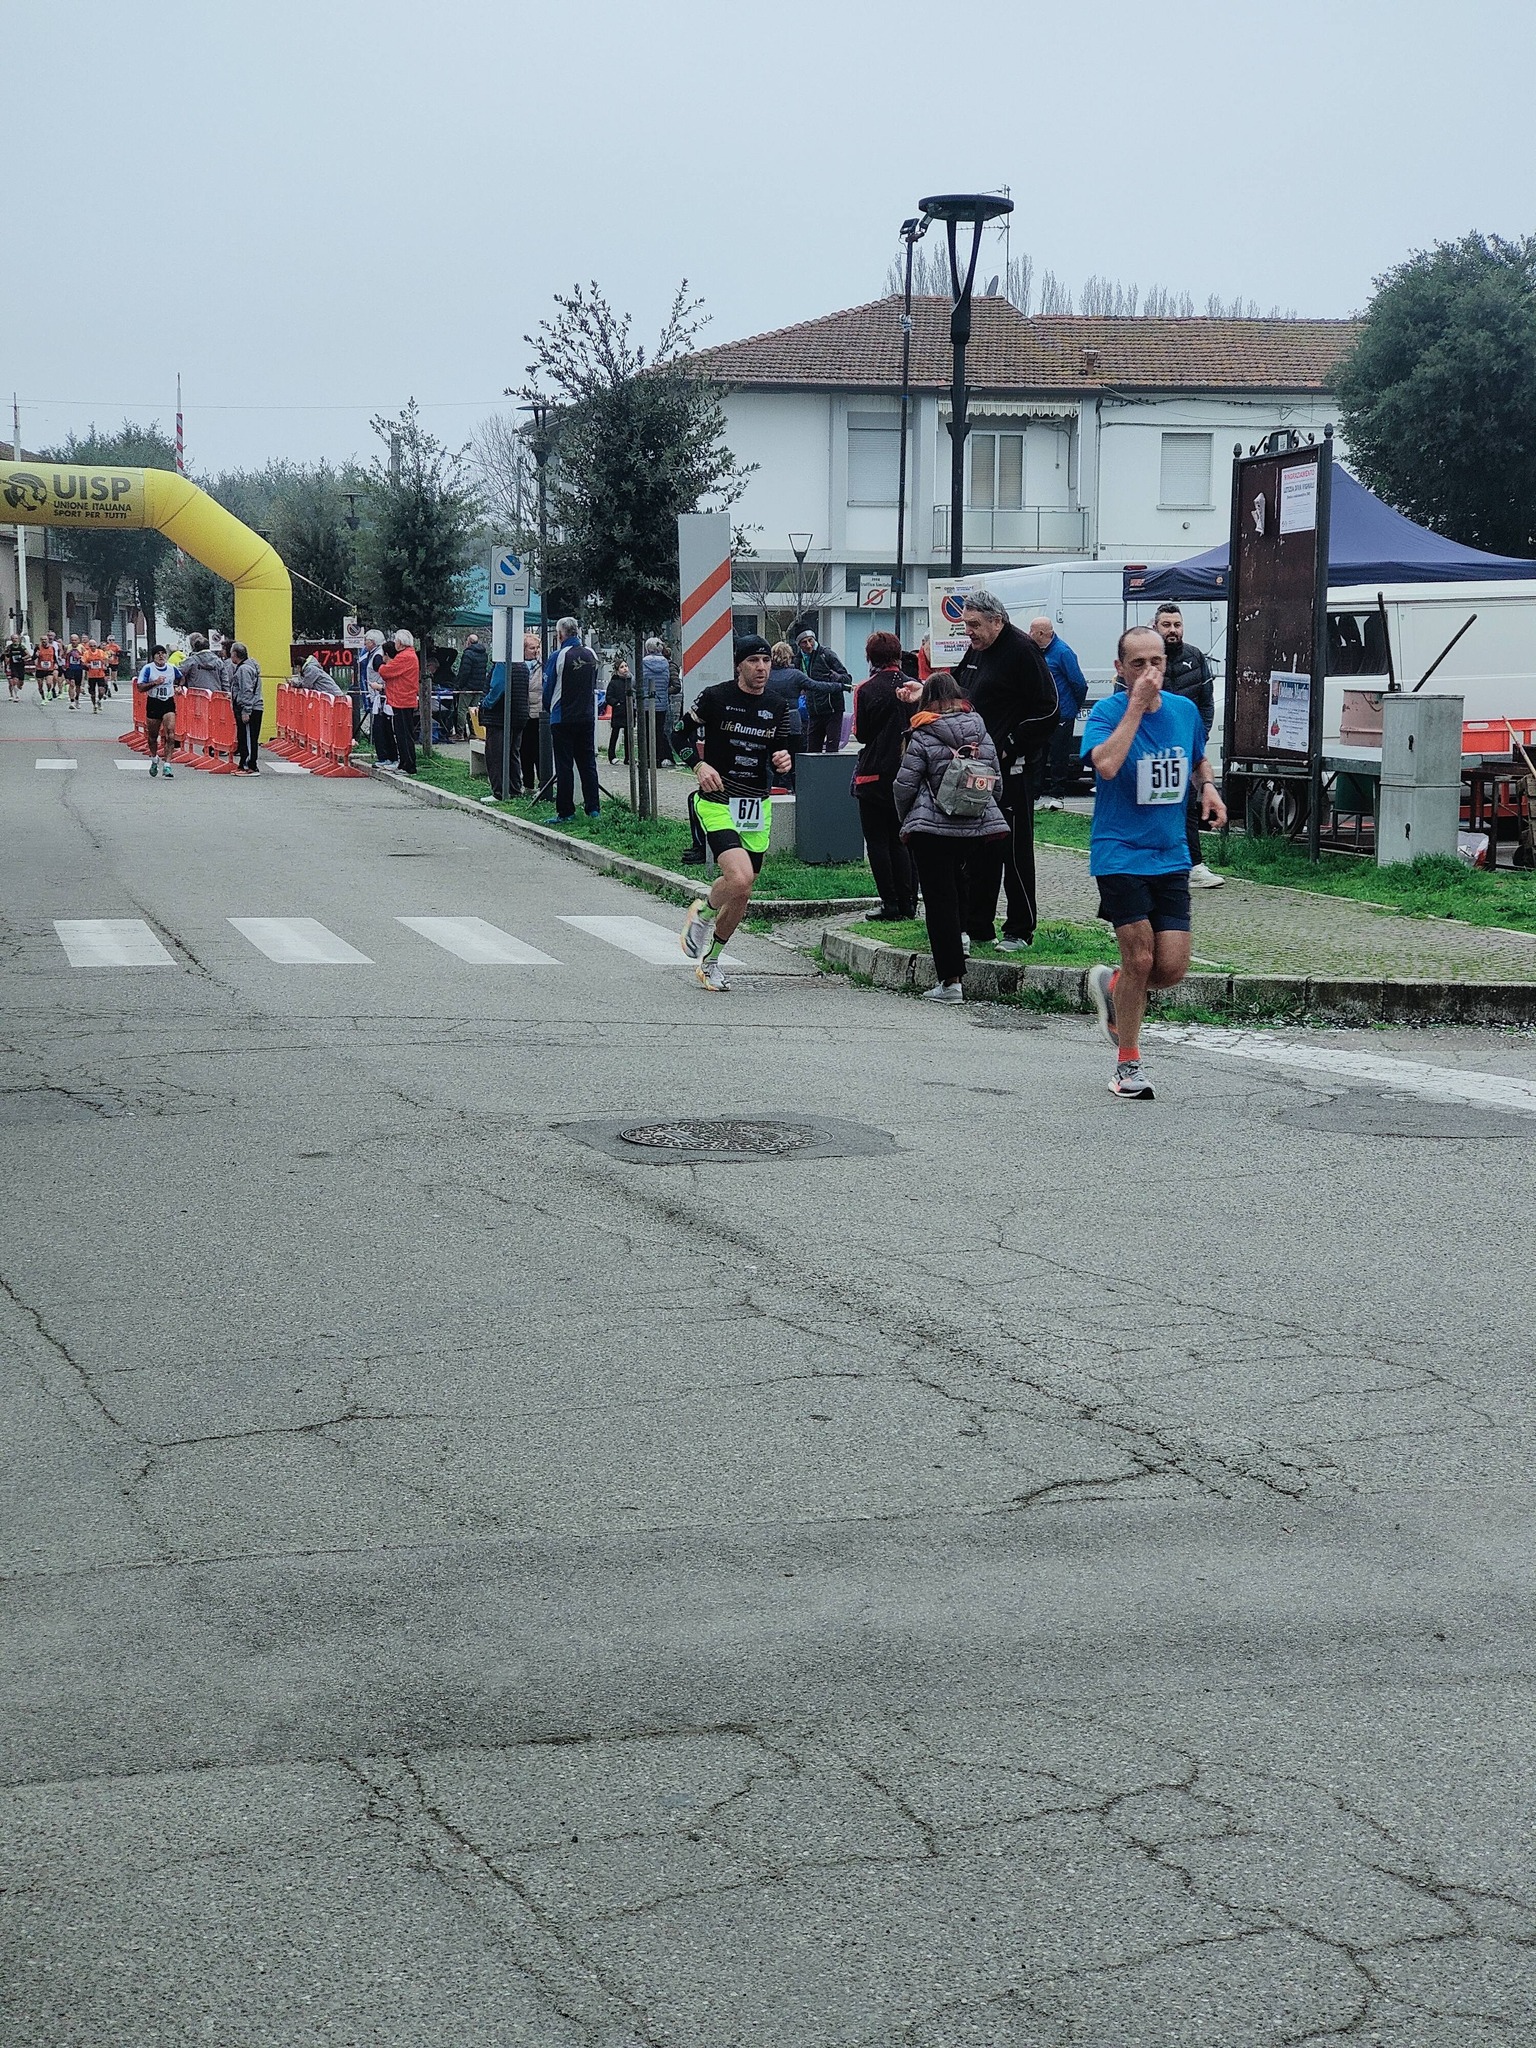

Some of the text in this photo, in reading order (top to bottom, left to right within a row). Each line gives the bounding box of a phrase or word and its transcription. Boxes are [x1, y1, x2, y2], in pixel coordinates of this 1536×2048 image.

[53, 474, 131, 501] UISP
[53, 501, 131, 511] UNIONE ITALIANA
[496, 584, 504, 594] P
[720, 721, 772, 739] LifeRunner.it
[1152, 760, 1180, 788] 515
[739, 799, 760, 820] 671
